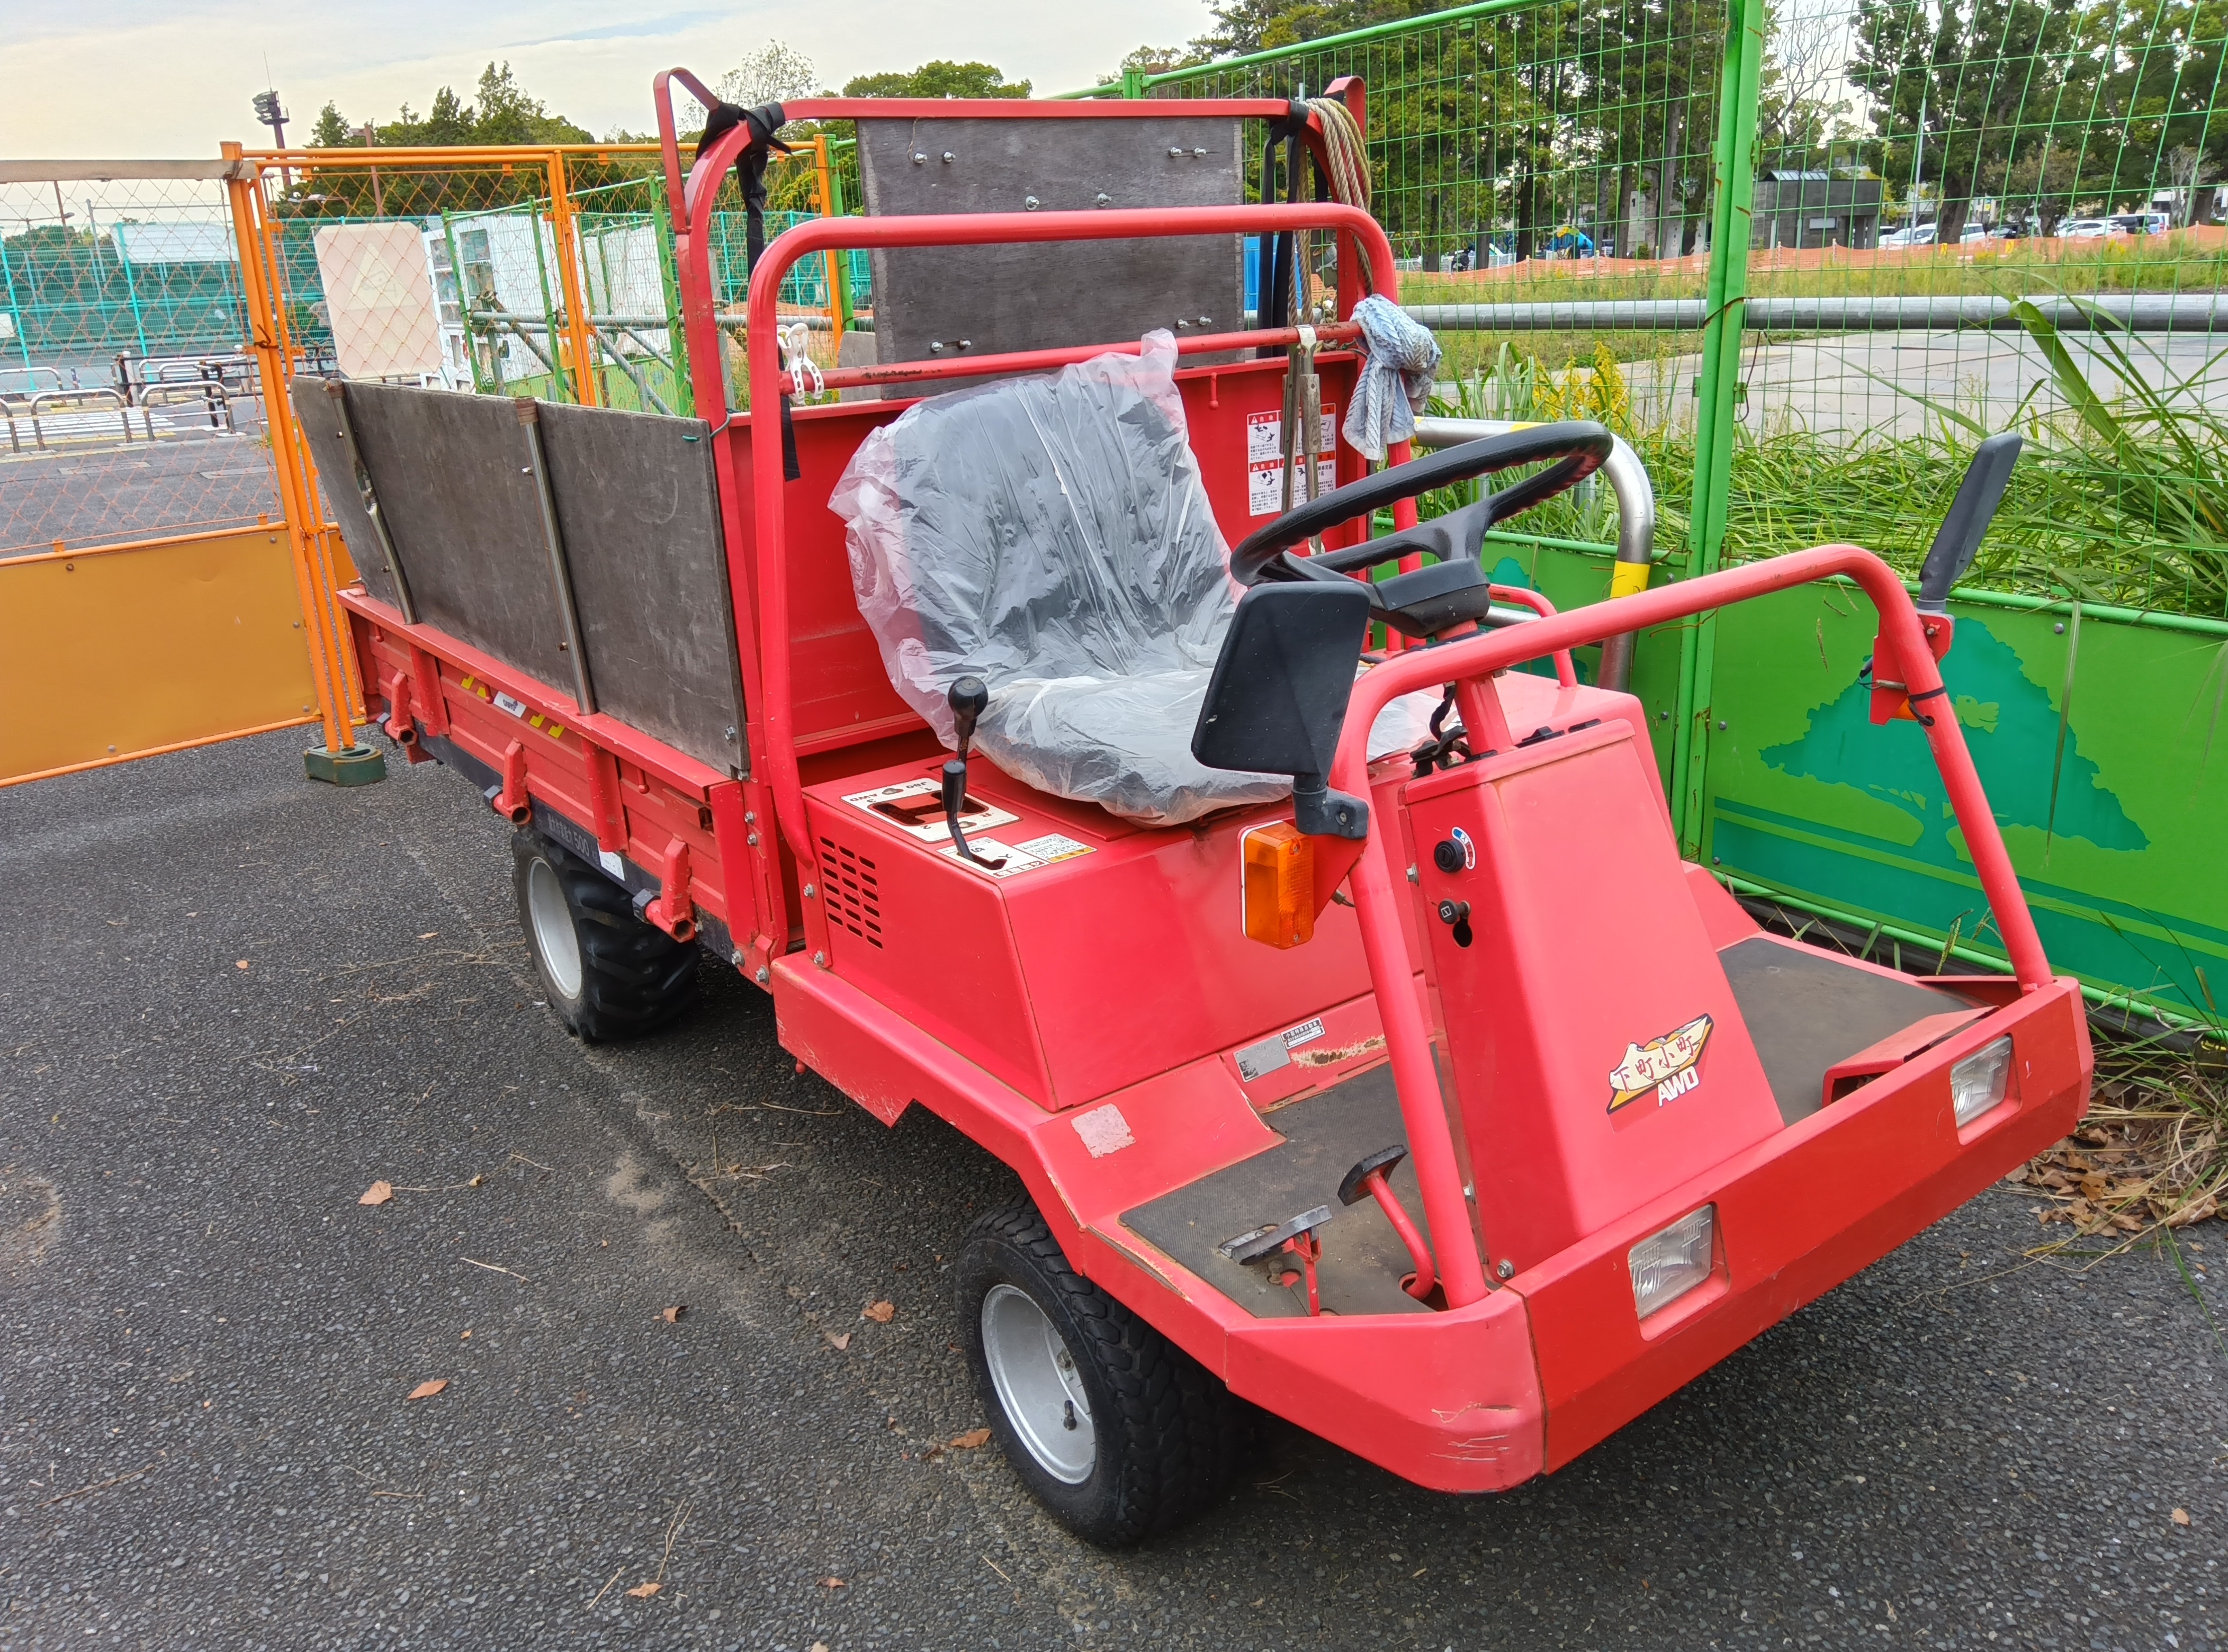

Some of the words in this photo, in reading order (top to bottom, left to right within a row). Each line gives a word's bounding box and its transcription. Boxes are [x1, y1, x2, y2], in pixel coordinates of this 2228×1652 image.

[849, 793, 877, 802] AWD
[574, 830, 589, 857] 500
[1286, 1021, 1318, 1038] 小型特殊自動車
[1614, 1035, 1696, 1094] 下町小町
[1658, 1066, 1700, 1107] AWD
